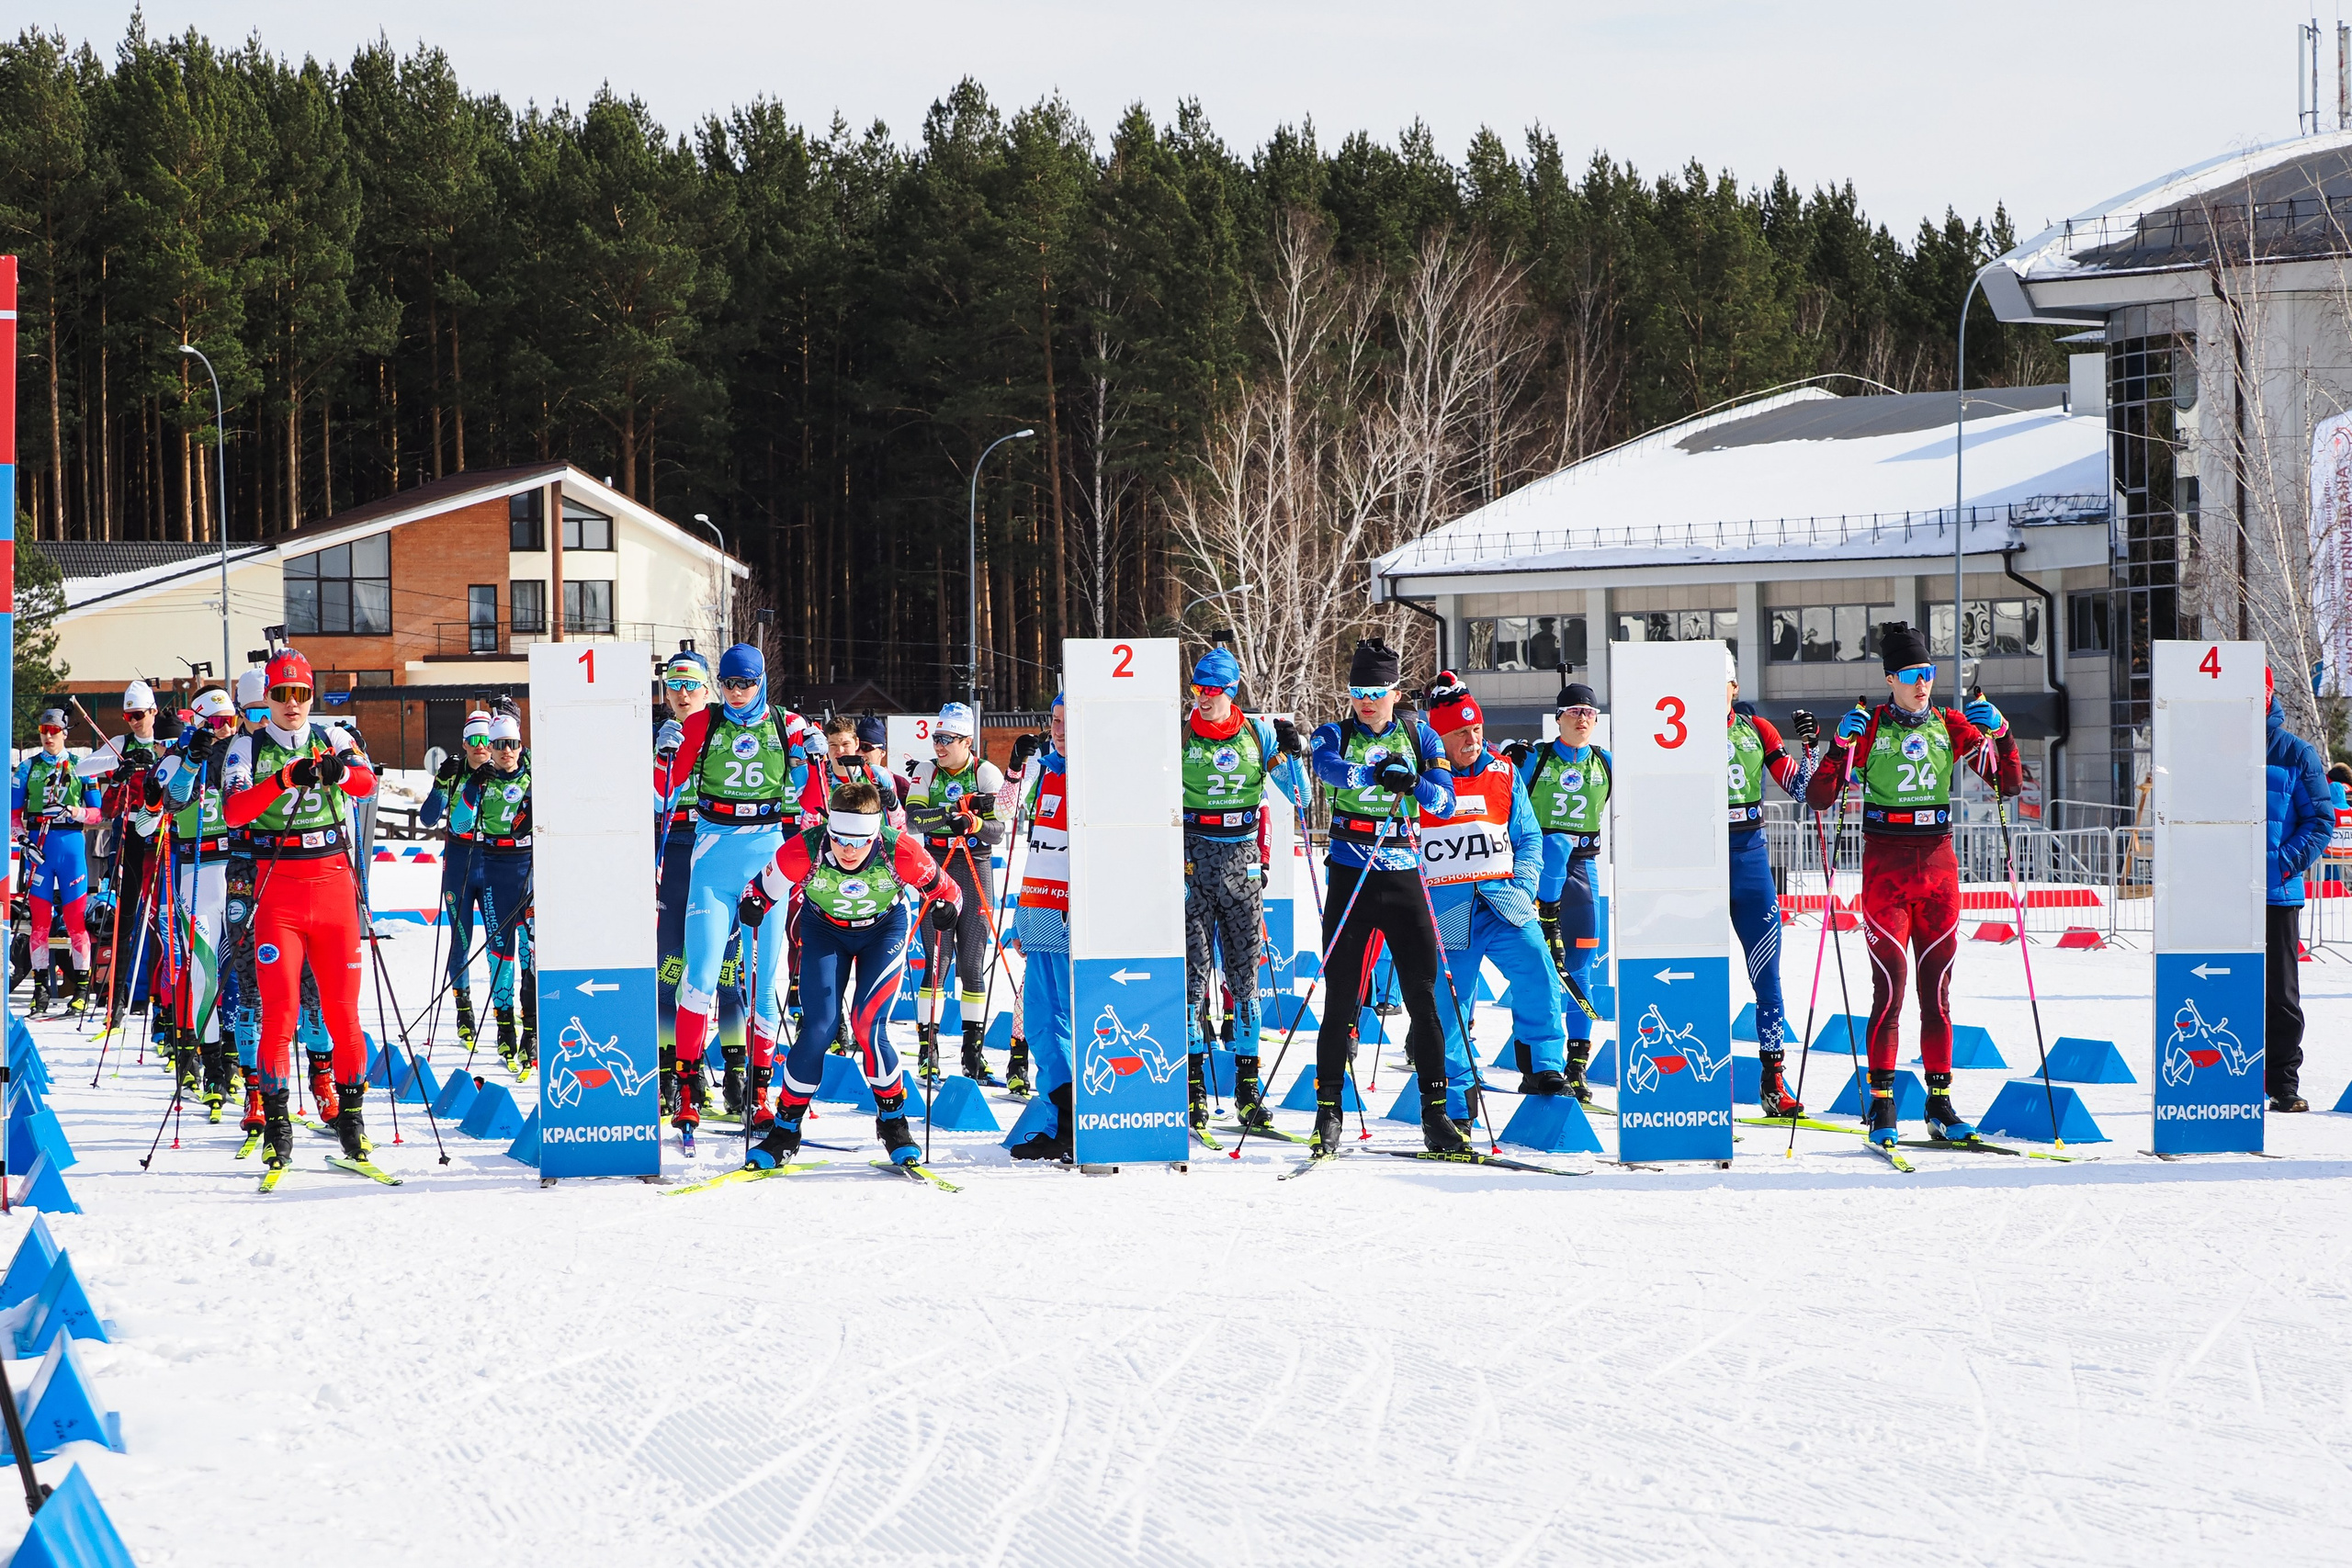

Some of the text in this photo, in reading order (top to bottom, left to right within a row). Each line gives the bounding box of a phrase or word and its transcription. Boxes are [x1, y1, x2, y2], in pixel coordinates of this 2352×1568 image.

[578, 649, 594, 682] 1
[1113, 645, 1134, 678] 2
[2199, 647, 2222, 679] 4
[915, 720, 929, 740] 3
[1655, 696, 1687, 750] 3
[724, 761, 764, 788] 26
[1207, 774, 1247, 795] 27
[1896, 762, 1937, 792] 24
[282, 784, 322, 816] 25
[1551, 793, 1589, 819] 32
[1424, 831, 1510, 862] СУДЬЯ
[833, 899, 877, 915] 22
[1078, 1111, 1186, 1130] КРАСНОЯРСК
[1622, 1111, 1730, 1128] КРАСНОЯРСК
[2156, 1104, 2261, 1121] КРАСНОЯРСК
[542, 1124, 657, 1144] КРАСНОЯРСК
[1416, 1152, 1472, 1164] FISCHER
